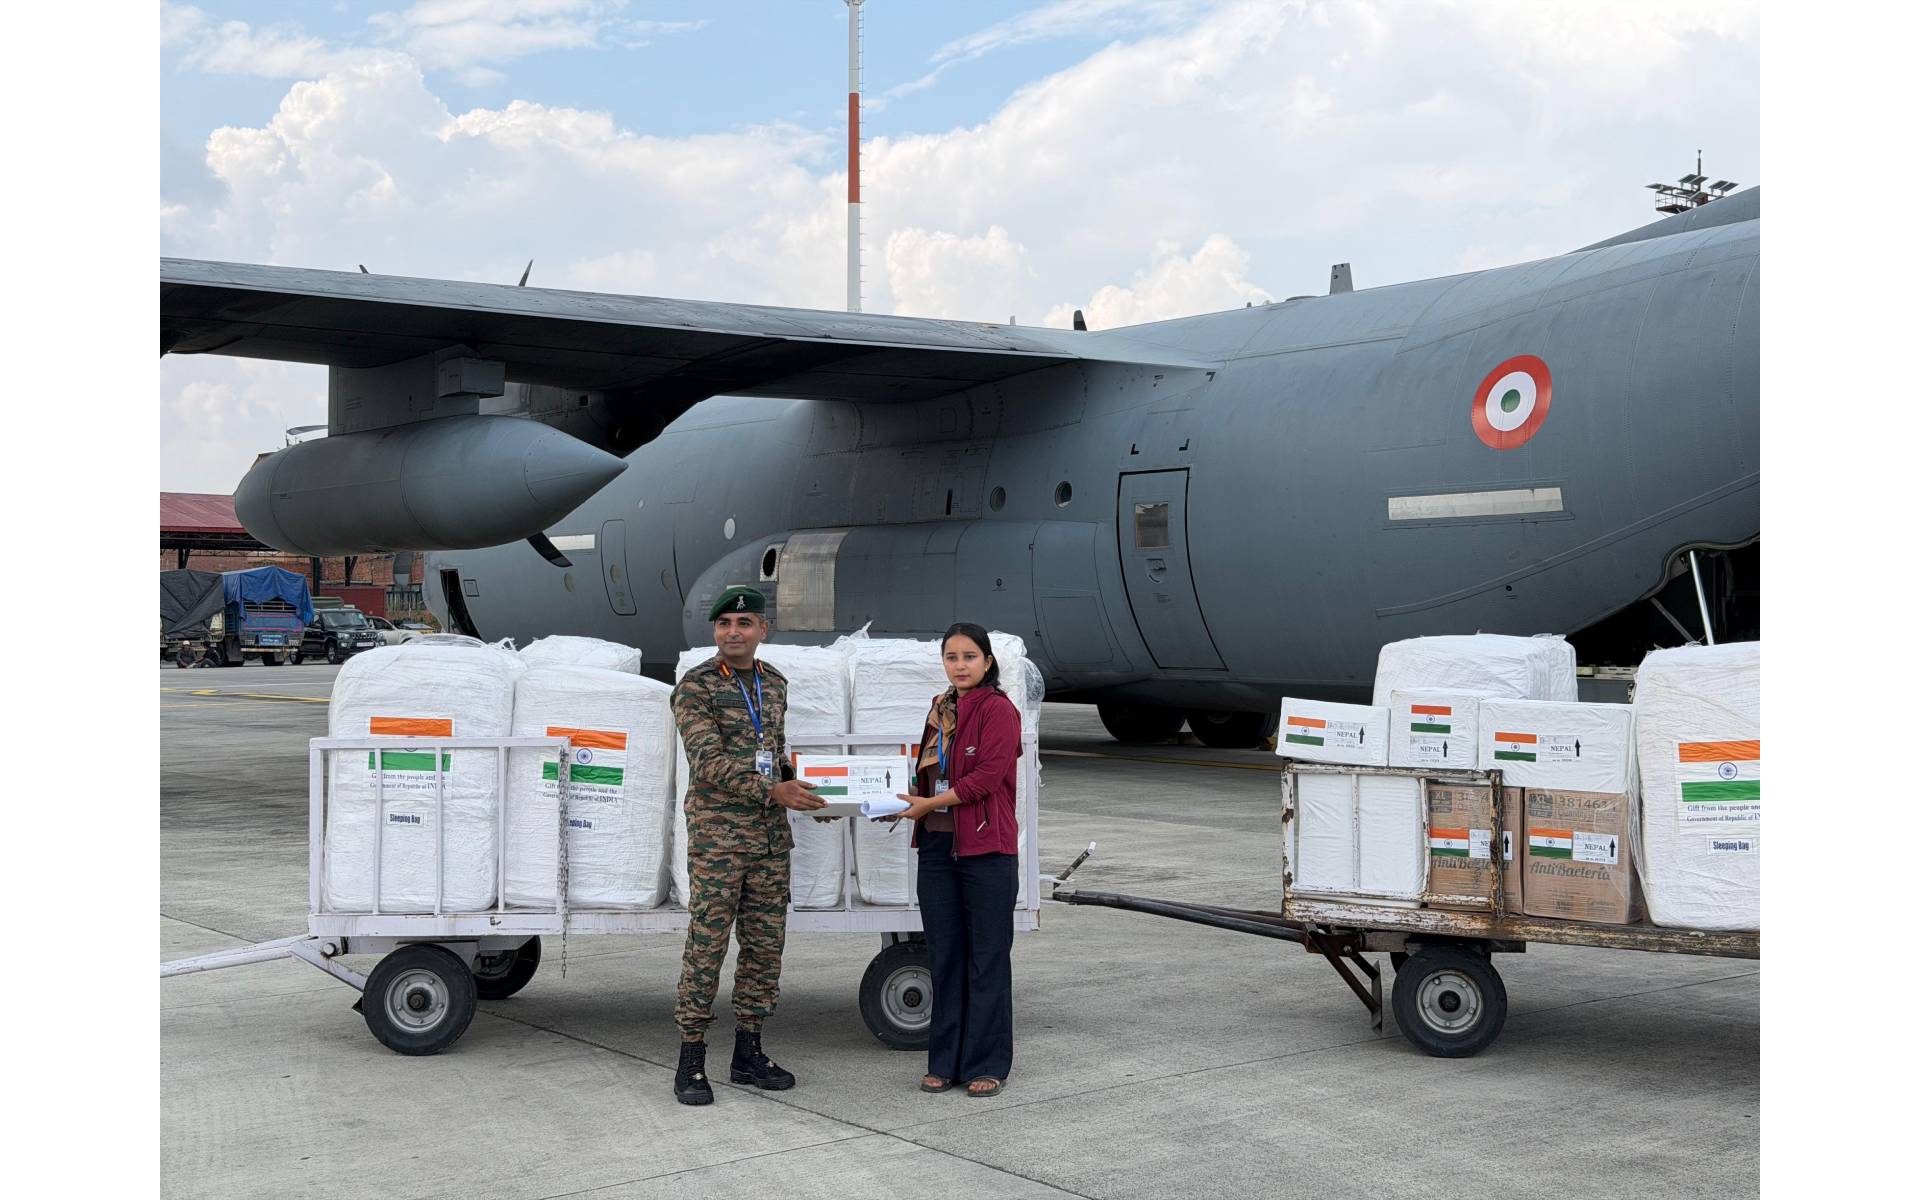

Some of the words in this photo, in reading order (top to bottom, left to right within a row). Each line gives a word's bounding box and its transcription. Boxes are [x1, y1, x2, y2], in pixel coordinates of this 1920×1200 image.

[1337, 731, 1358, 739] NEPAL
[860, 776, 883, 784] NEPAL
[1687, 804, 1700, 812] Gift
[1701, 804, 1717, 812] from
[1729, 804, 1748, 812] people
[389, 813, 411, 824] Sleeping
[411, 814, 421, 824] Bag
[583, 820, 592, 829] Bag
[1584, 843, 1609, 852] NEPAL
[1712, 841, 1738, 851] Sleeping
[1738, 840, 1749, 851] Bag
